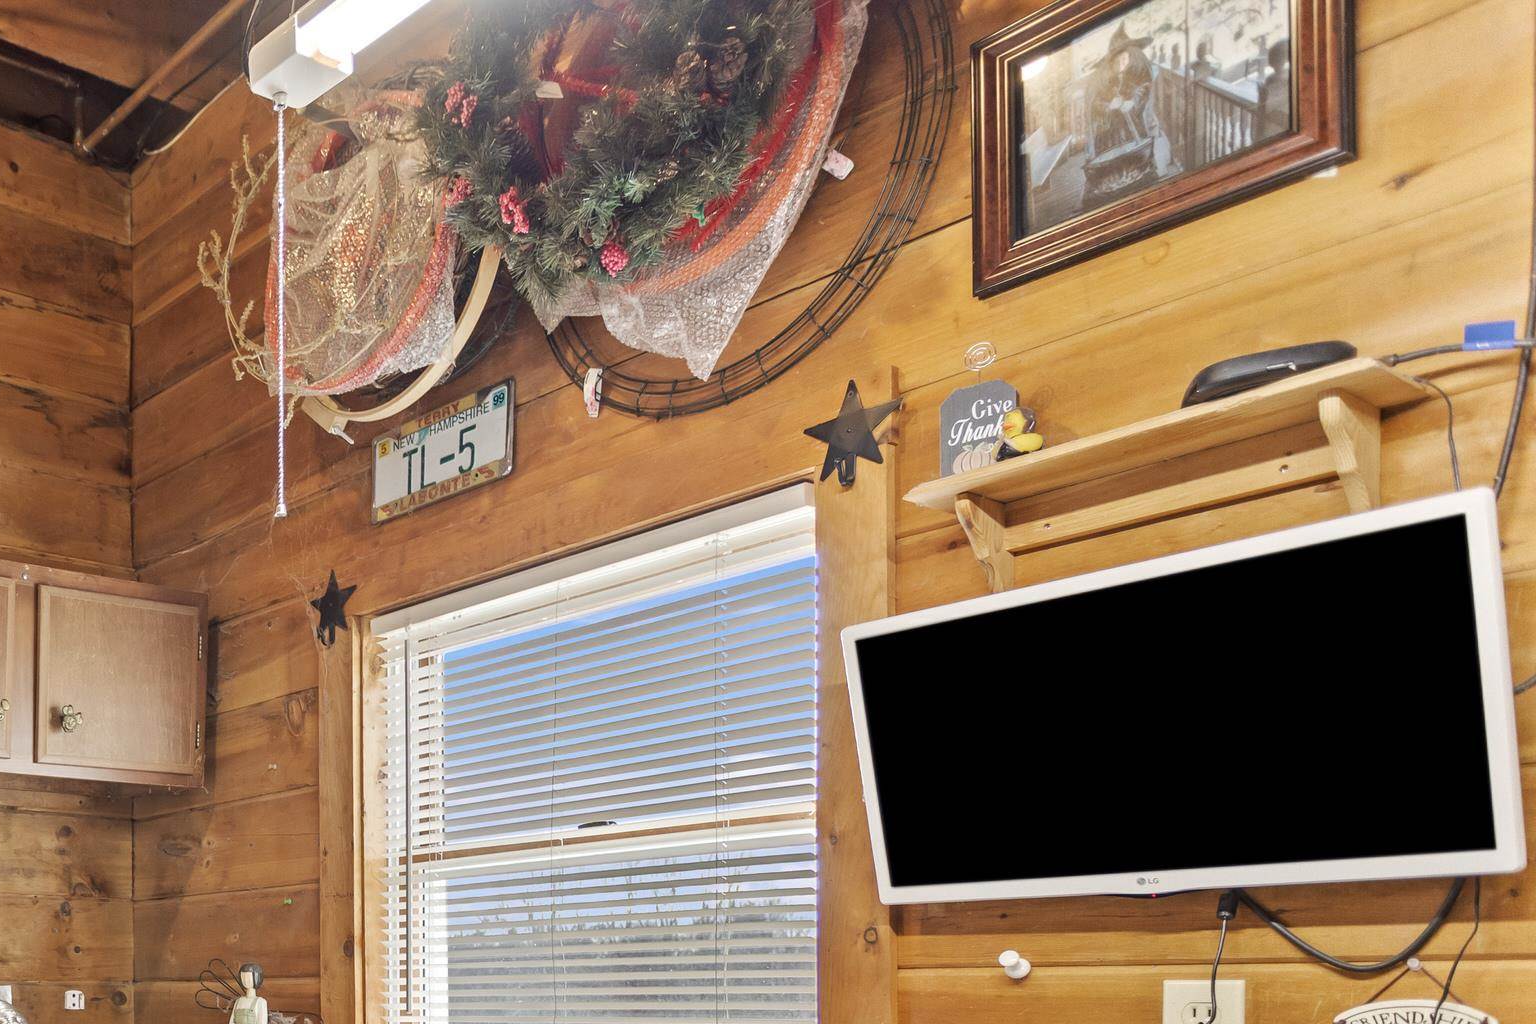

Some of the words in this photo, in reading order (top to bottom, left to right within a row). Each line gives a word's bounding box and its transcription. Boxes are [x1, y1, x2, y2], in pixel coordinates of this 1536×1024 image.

[493, 393, 505, 406] 99
[971, 398, 1013, 420] Give
[393, 433, 415, 451] NEW
[429, 401, 490, 436] HAMPSHIRE
[417, 402, 460, 428] TERRY
[948, 414, 1005, 447] Thank
[380, 443, 388, 455] 5
[1147, 877, 1159, 885] LG
